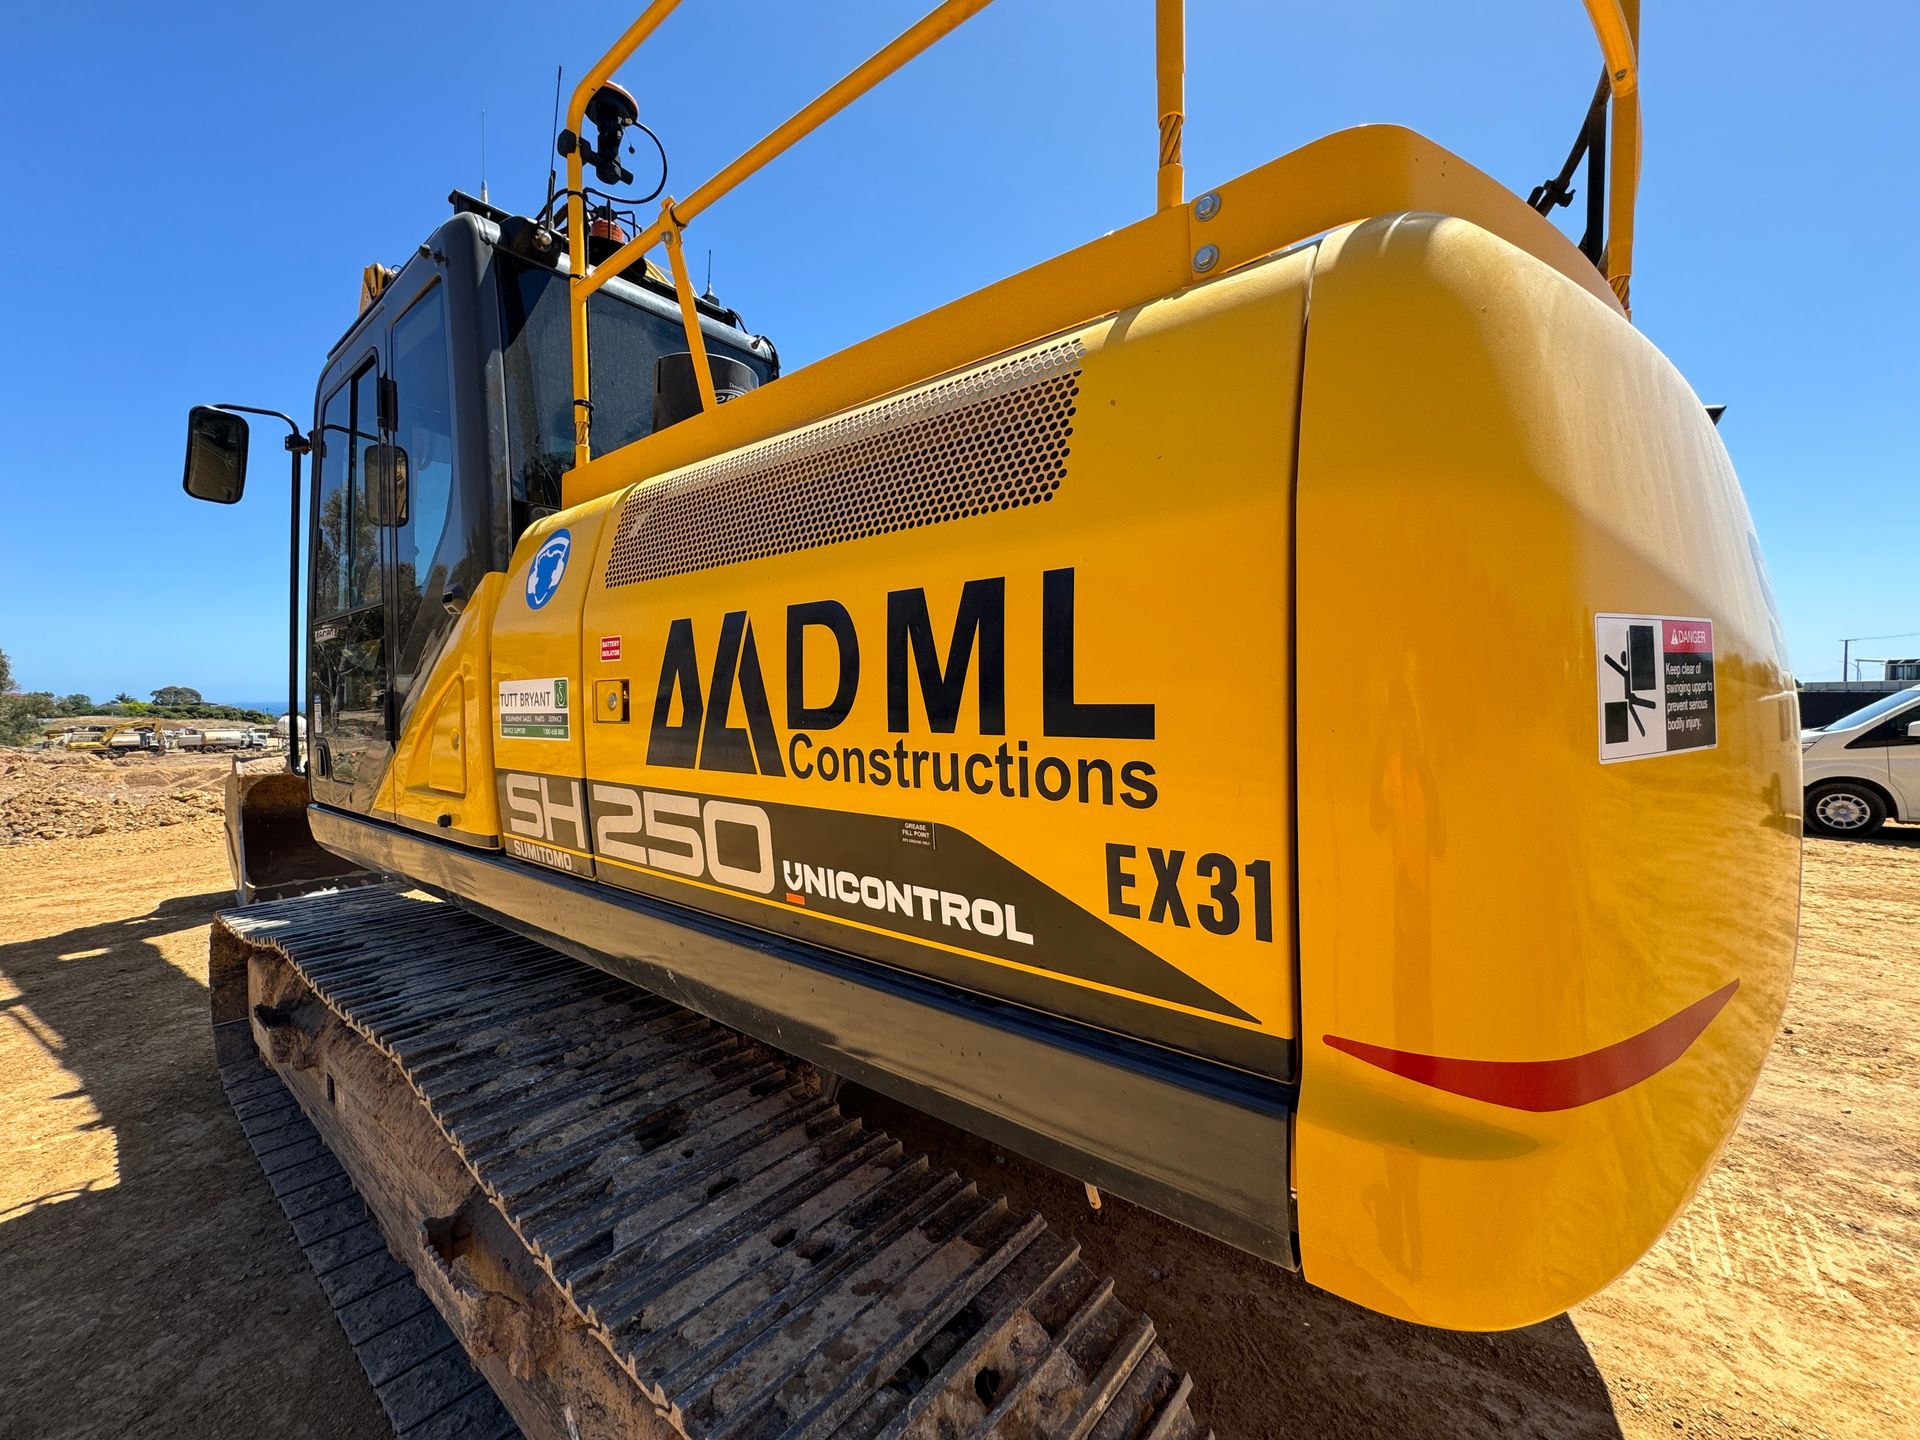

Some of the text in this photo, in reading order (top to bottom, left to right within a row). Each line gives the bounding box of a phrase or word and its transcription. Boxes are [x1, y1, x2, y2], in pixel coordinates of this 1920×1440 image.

[602, 640, 620, 648] BATTERY
[1678, 630, 1706, 644] DANGER
[1665, 662, 1702, 677] Keep clear of
[1666, 680, 1713, 696] swinging upper to
[499, 691, 551, 707] TUTT BRYANT
[1667, 697, 1708, 715] prevent serious
[1667, 715, 1702, 732] bodily injury.
[788, 733, 1158, 809] Constructions
[904, 822, 927, 831] GREASE
[913, 830, 930, 839] POINT
[514, 839, 572, 872] SUMITOMO
[1105, 842, 1273, 944] EX31
[783, 860, 1034, 945] UNICONTROL
